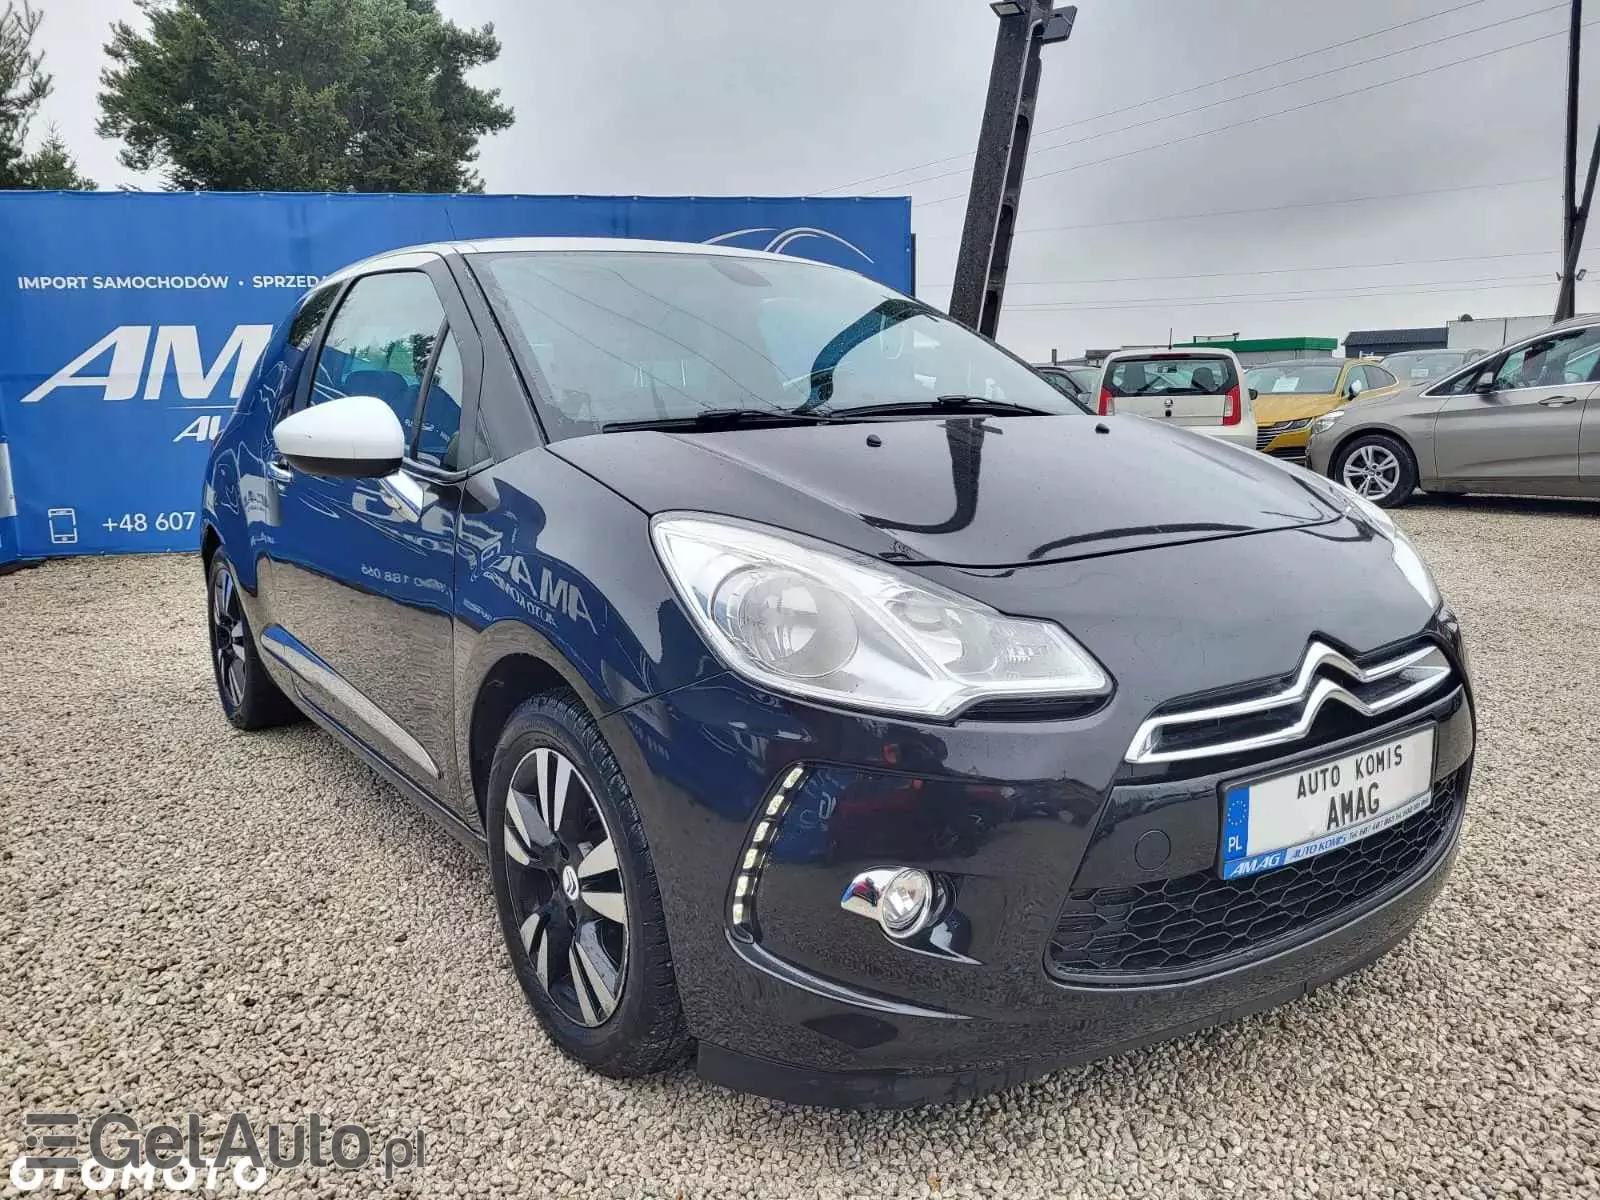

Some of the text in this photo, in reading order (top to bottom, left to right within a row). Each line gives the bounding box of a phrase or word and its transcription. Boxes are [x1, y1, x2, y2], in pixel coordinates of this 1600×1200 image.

[17, 273, 325, 289] IMPORT SAMOCHODÓW SPRZED
[102, 511, 196, 532] +48 607
[1297, 744, 1403, 800] AUTO KOMIS
[1327, 782, 1380, 831] AMAG
[1228, 835, 1243, 853] PL
[1231, 852, 1281, 876] AMAG
